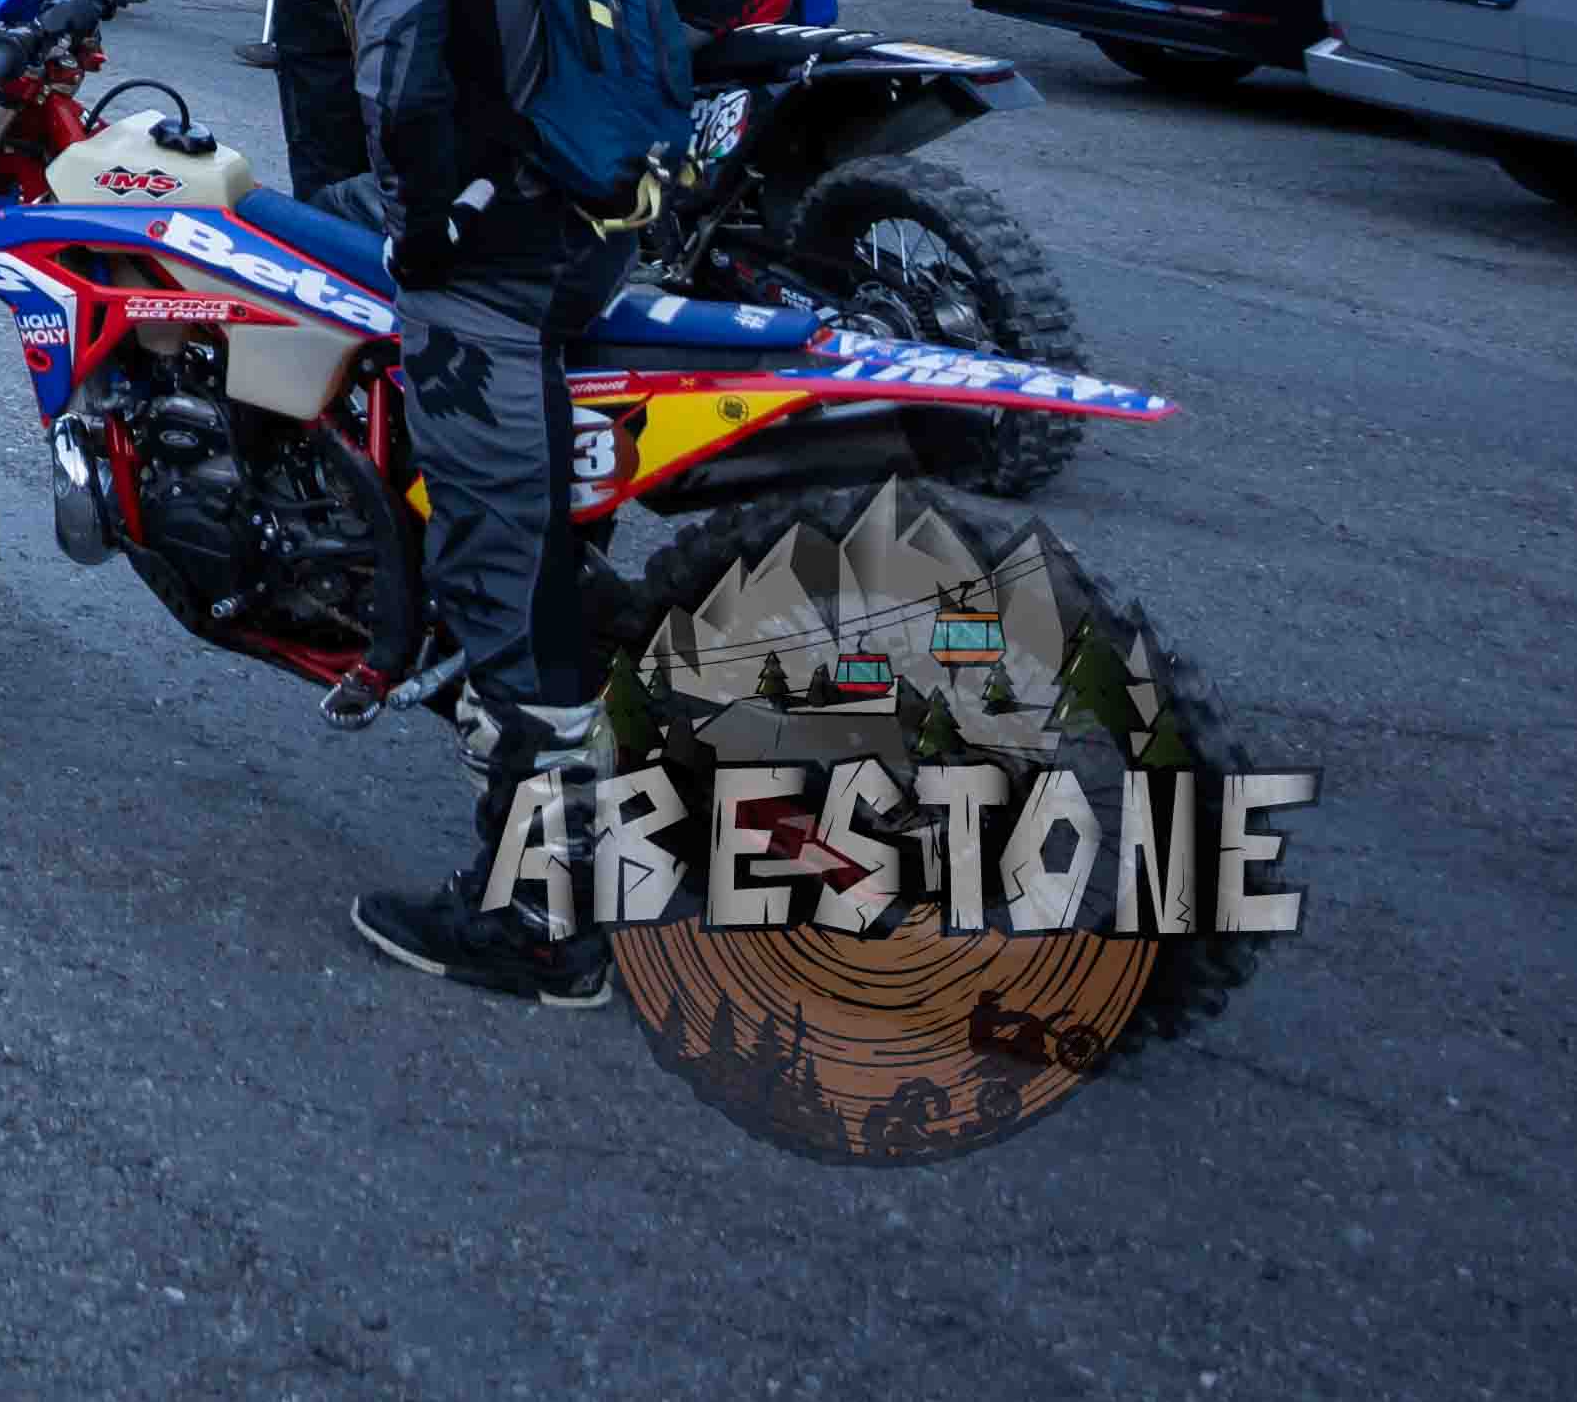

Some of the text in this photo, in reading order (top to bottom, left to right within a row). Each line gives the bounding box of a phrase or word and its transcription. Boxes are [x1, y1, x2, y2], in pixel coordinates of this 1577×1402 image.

[97, 169, 181, 193] IMS
[165, 210, 396, 336] Beta
[17, 313, 63, 329] LIQUI
[125, 308, 229, 320] RACE PARTS
[21, 328, 69, 345] MOLY
